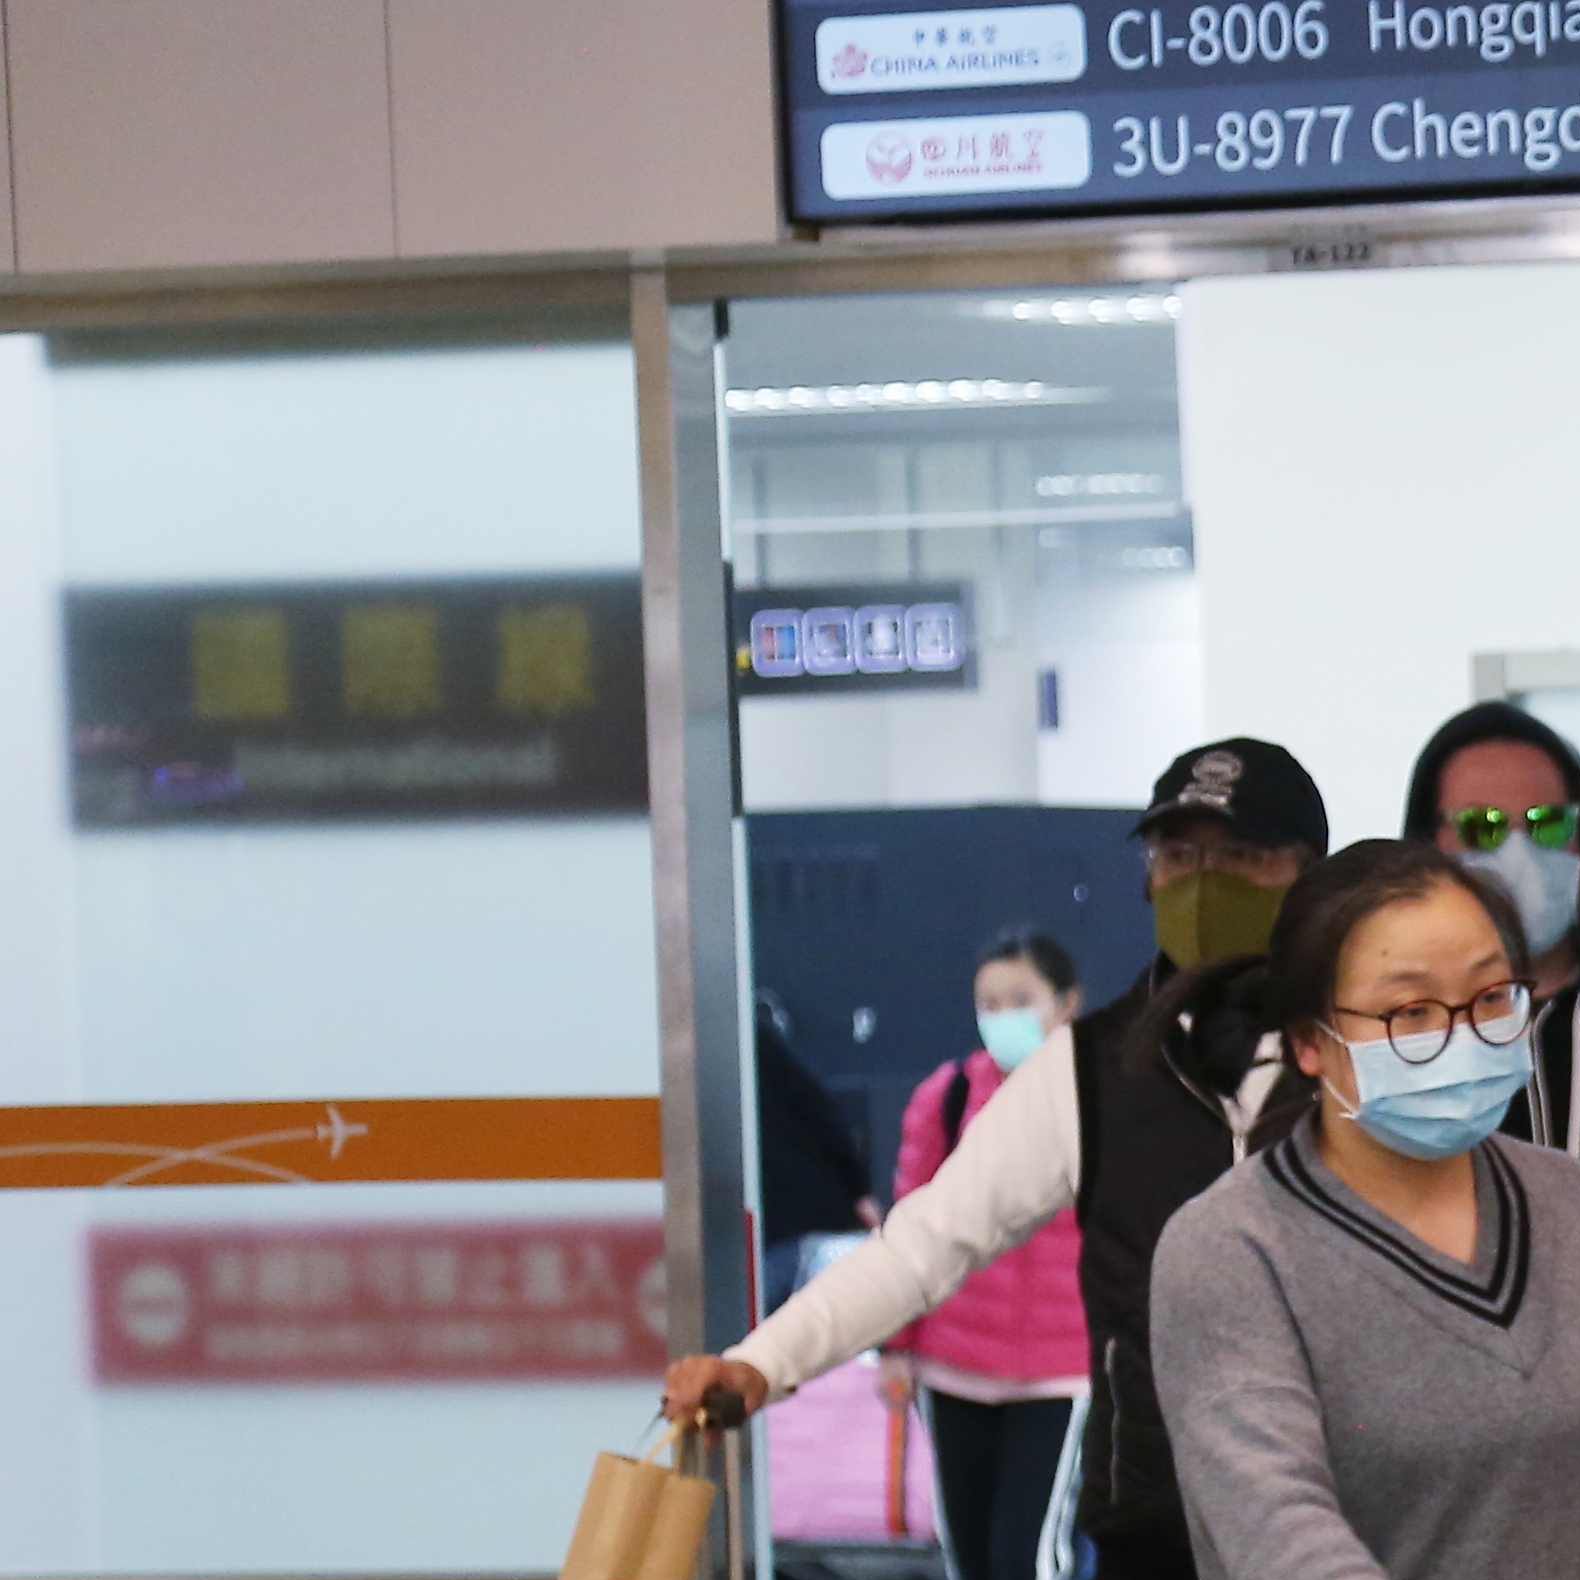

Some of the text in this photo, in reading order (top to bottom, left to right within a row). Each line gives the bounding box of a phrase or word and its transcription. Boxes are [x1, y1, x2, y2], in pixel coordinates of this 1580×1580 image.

[869, 48, 1040, 76] CHINA AIRLINES
[1108, 1, 1329, 70] CI-8006
[1112, 105, 1353, 178] 3U-8977
